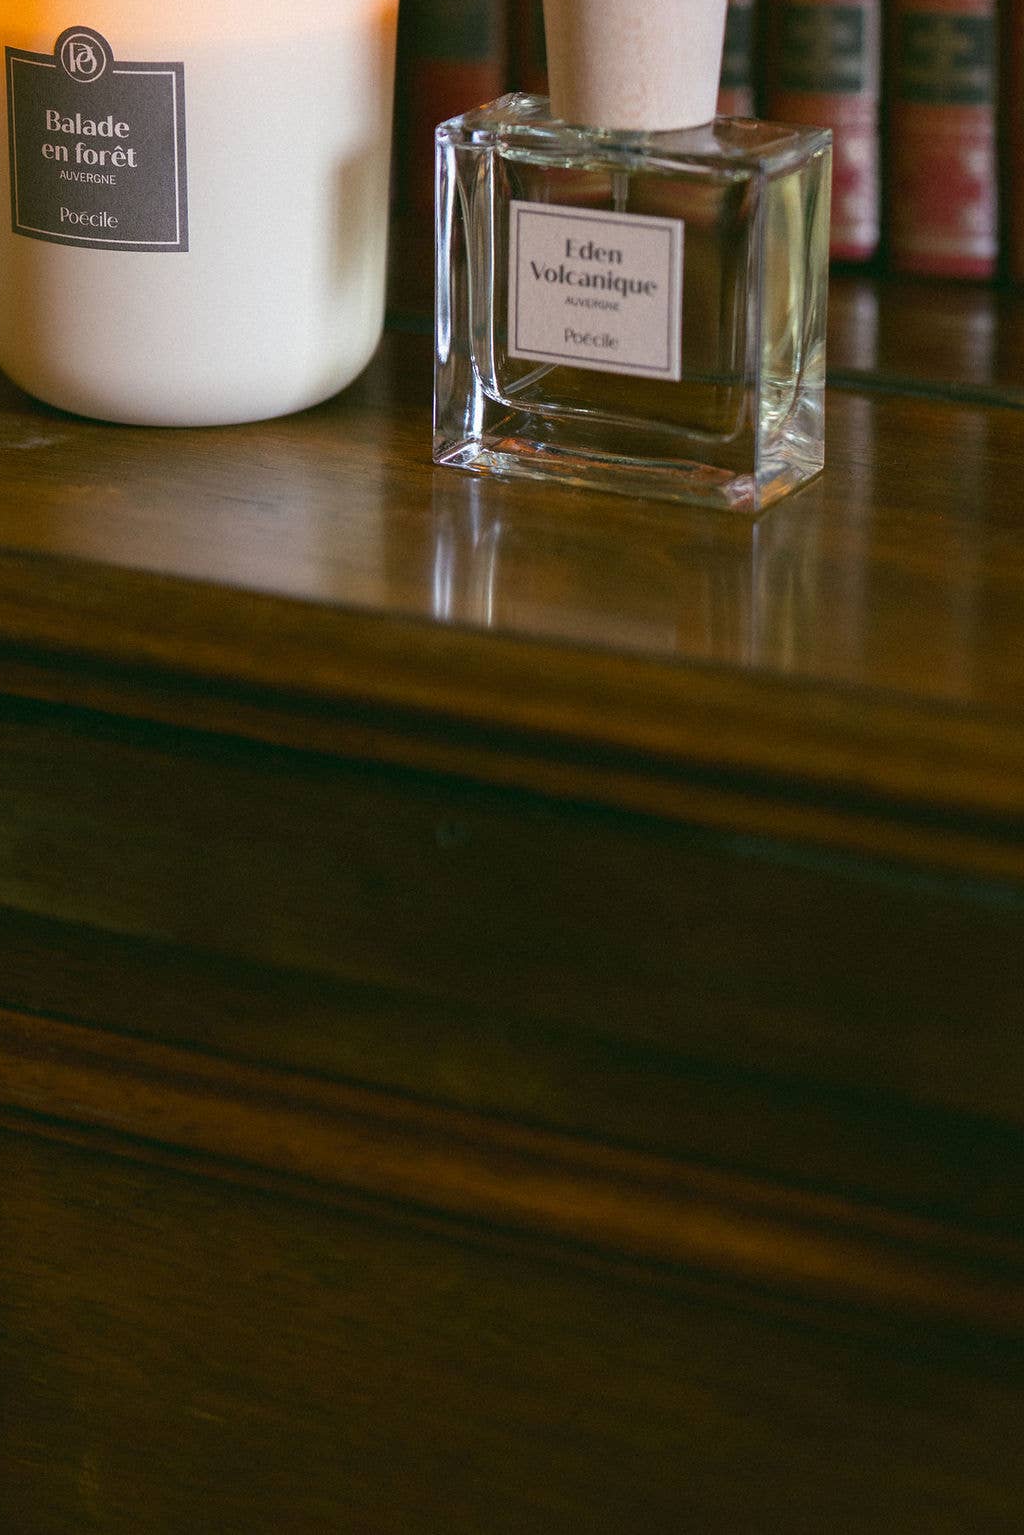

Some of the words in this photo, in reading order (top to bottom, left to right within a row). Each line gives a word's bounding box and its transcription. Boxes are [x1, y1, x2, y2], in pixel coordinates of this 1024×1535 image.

[45, 109, 130, 138] Balade
[42, 143, 68, 162] en
[75, 142, 138, 168] forêt
[59, 170, 117, 185] AUVERGNE
[565, 238, 623, 265] Eden
[530, 260, 657, 298] Volcanique
